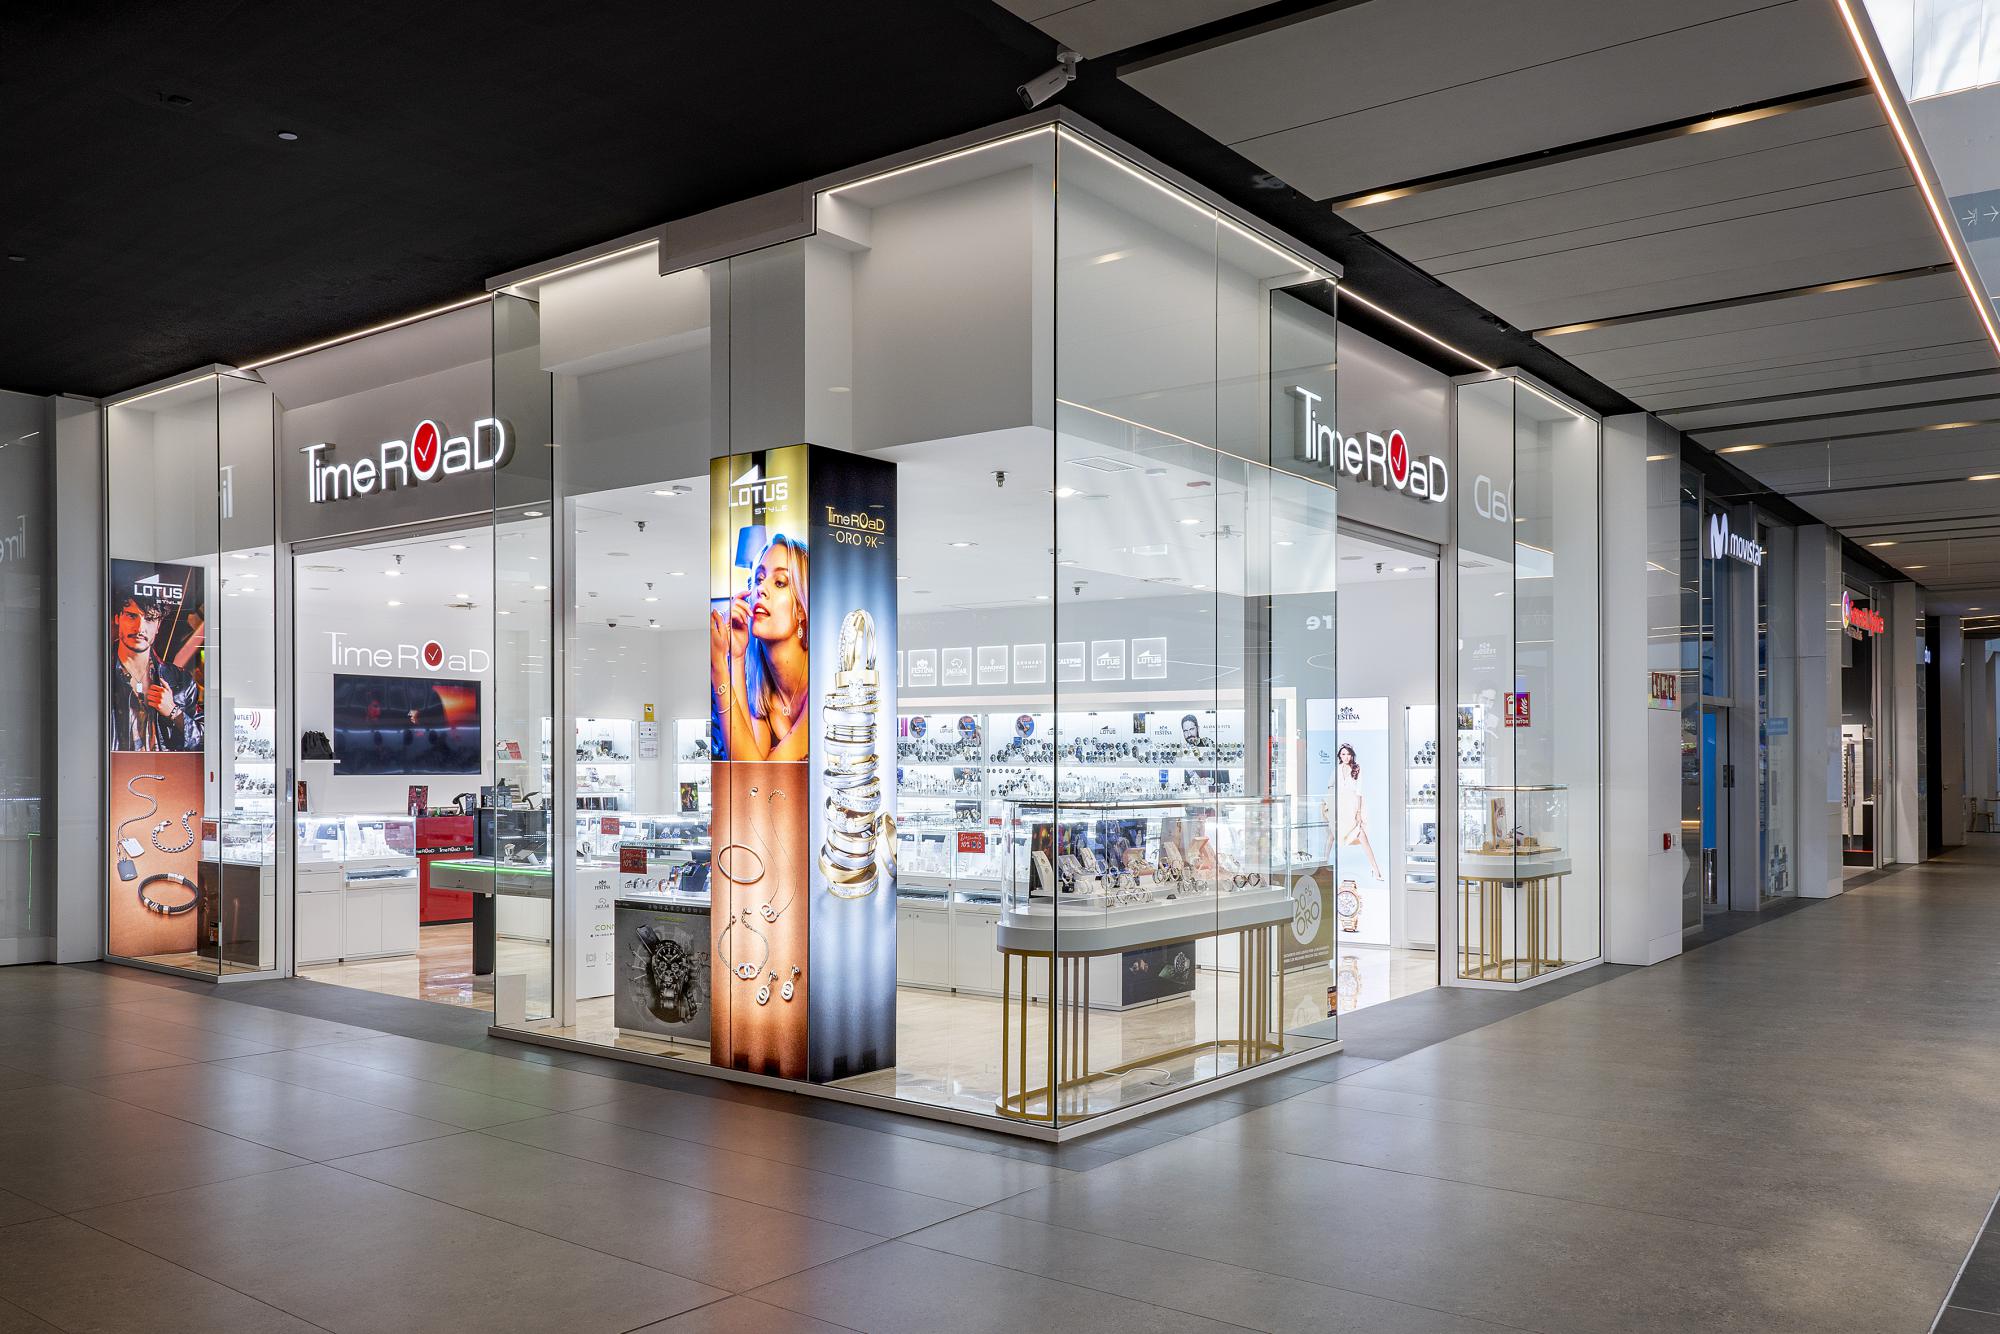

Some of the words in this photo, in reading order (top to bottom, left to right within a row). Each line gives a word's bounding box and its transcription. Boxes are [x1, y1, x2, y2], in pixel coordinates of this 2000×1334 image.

[729, 483, 789, 507] LOTUS
[1730, 533, 1763, 567] movistar
[134, 584, 183, 599] LOTUS
[1096, 658, 1120, 666] LOTUS
[1137, 656, 1161, 664] LOTUS
